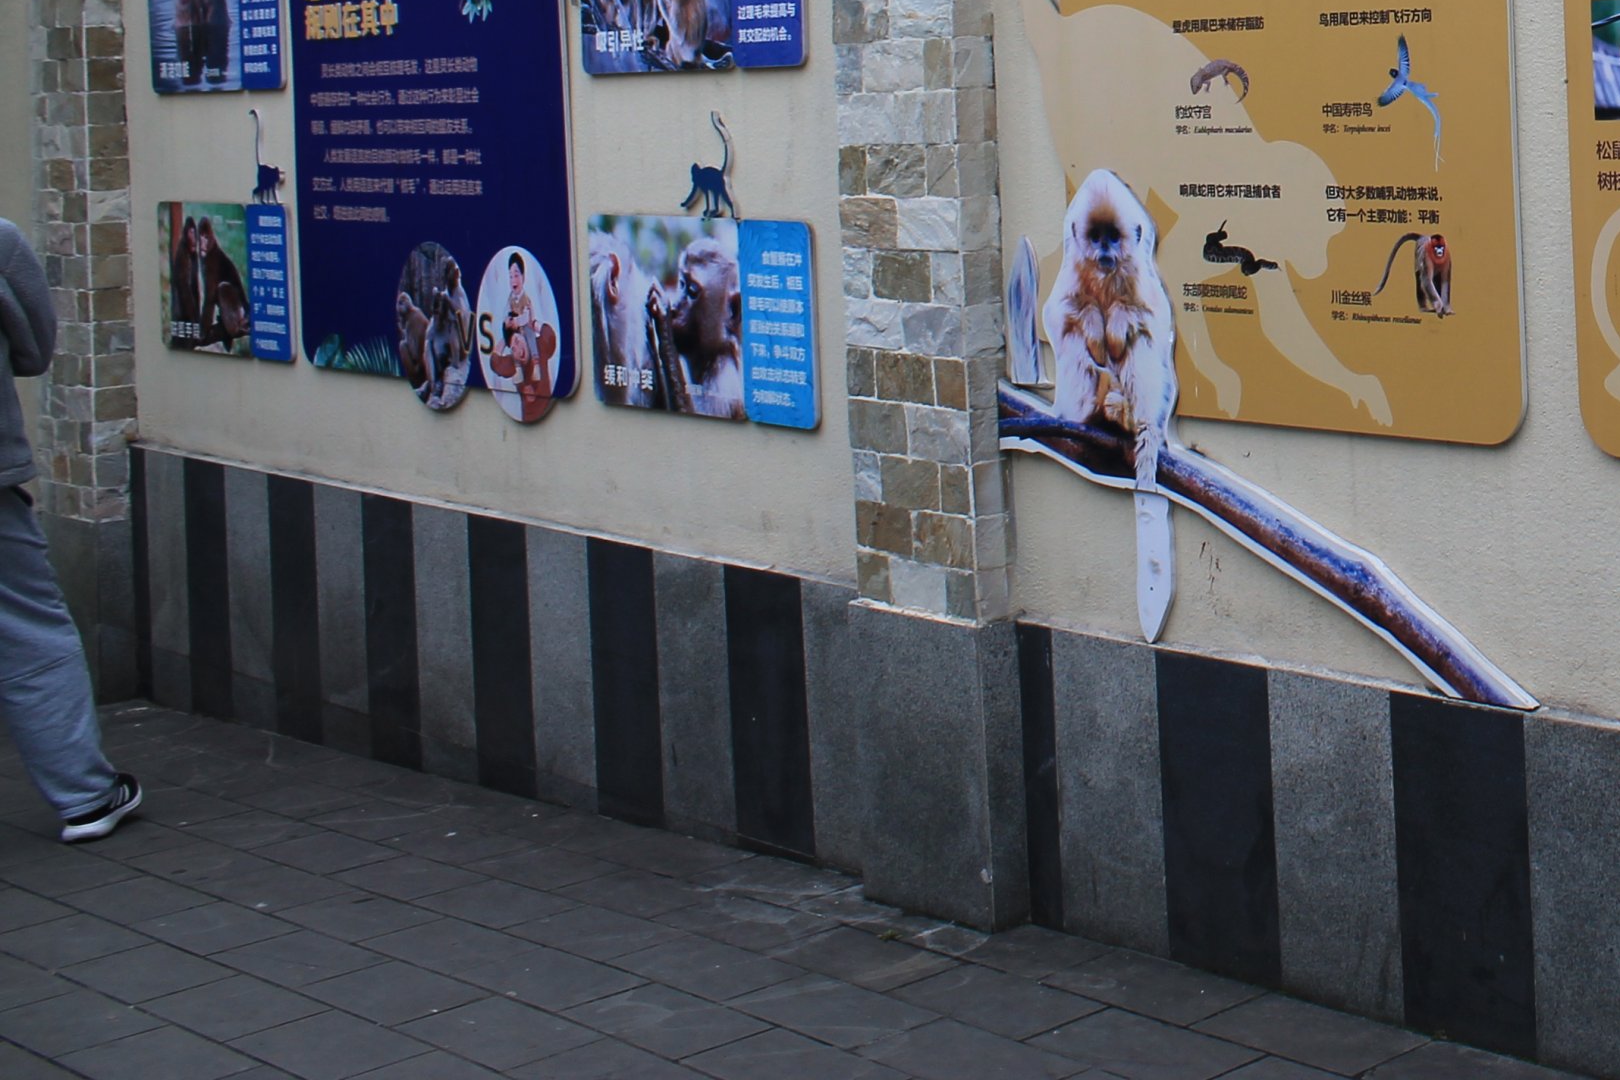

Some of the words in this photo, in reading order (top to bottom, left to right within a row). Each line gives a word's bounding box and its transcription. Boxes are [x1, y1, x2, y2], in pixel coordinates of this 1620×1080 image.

[1318, 8, 1432, 27] 鸟用尾巴来控制飞行方向
[1175, 105, 1212, 119] 豹纹守宫
[1322, 103, 1373, 118] 中国寿带鸟
[1179, 184, 1281, 199] 响尾蛇用它来吓退捕食者
[1325, 185, 1443, 201] 但对大多数哺乳动物来说，
[1326, 208, 1440, 224] 它有一个主要功能：平衡
[1331, 289, 1372, 306] 川金丝猴
[456, 309, 495, 355] VS
[604, 364, 653, 391] 缓和冲突
